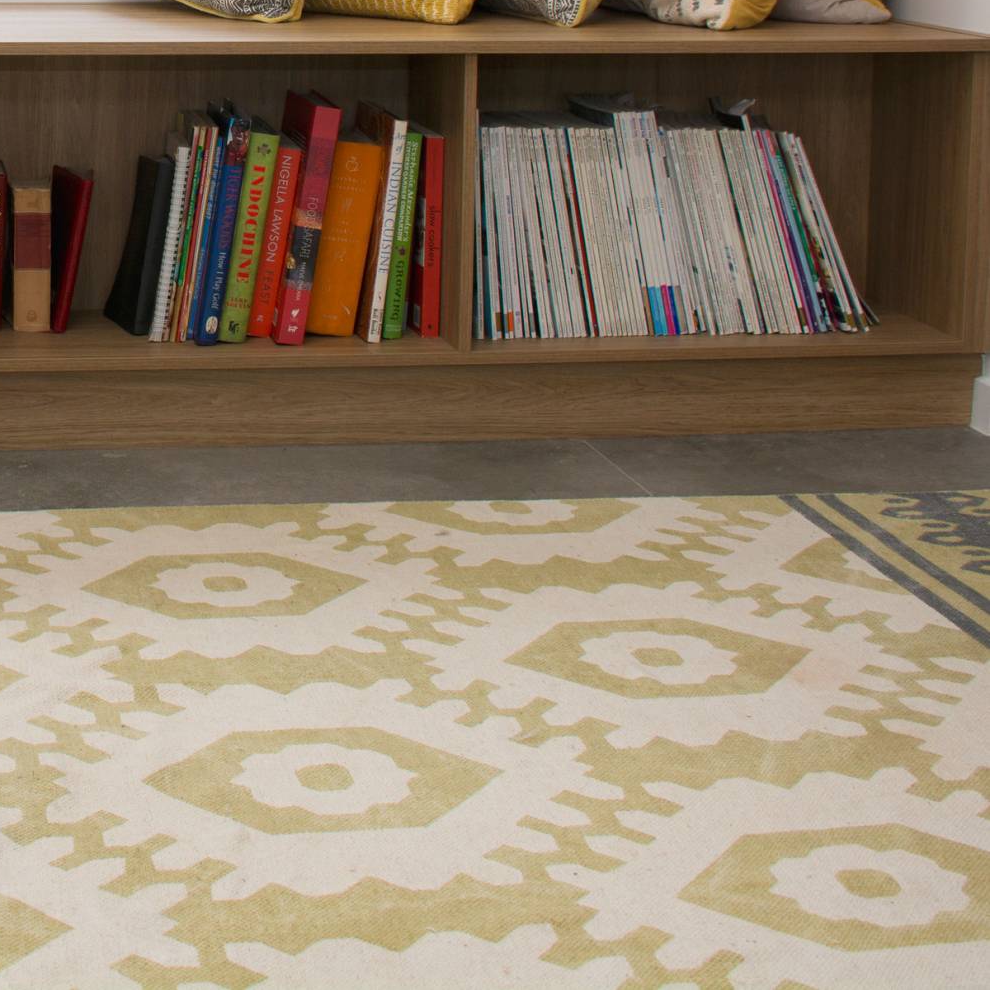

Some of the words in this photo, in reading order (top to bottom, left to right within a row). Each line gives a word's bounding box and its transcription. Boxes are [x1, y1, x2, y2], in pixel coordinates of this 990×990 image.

[274, 154, 293, 205] NIGELLA
[382, 161, 403, 213] INDIAN
[236, 164, 267, 284] INDOCHINE
[304, 196, 319, 226] FOOD
[428, 205, 436, 227] slow
[265, 209, 284, 262] LAWSON
[299, 226, 316, 260] SAFARI
[378, 218, 396, 275] CUISINE
[427, 229, 436, 268] cookers
[217, 252, 227, 269] How
[210, 293, 220, 310] Golf
[212, 275, 223, 291] Play
[258, 269, 274, 306] FEAST
